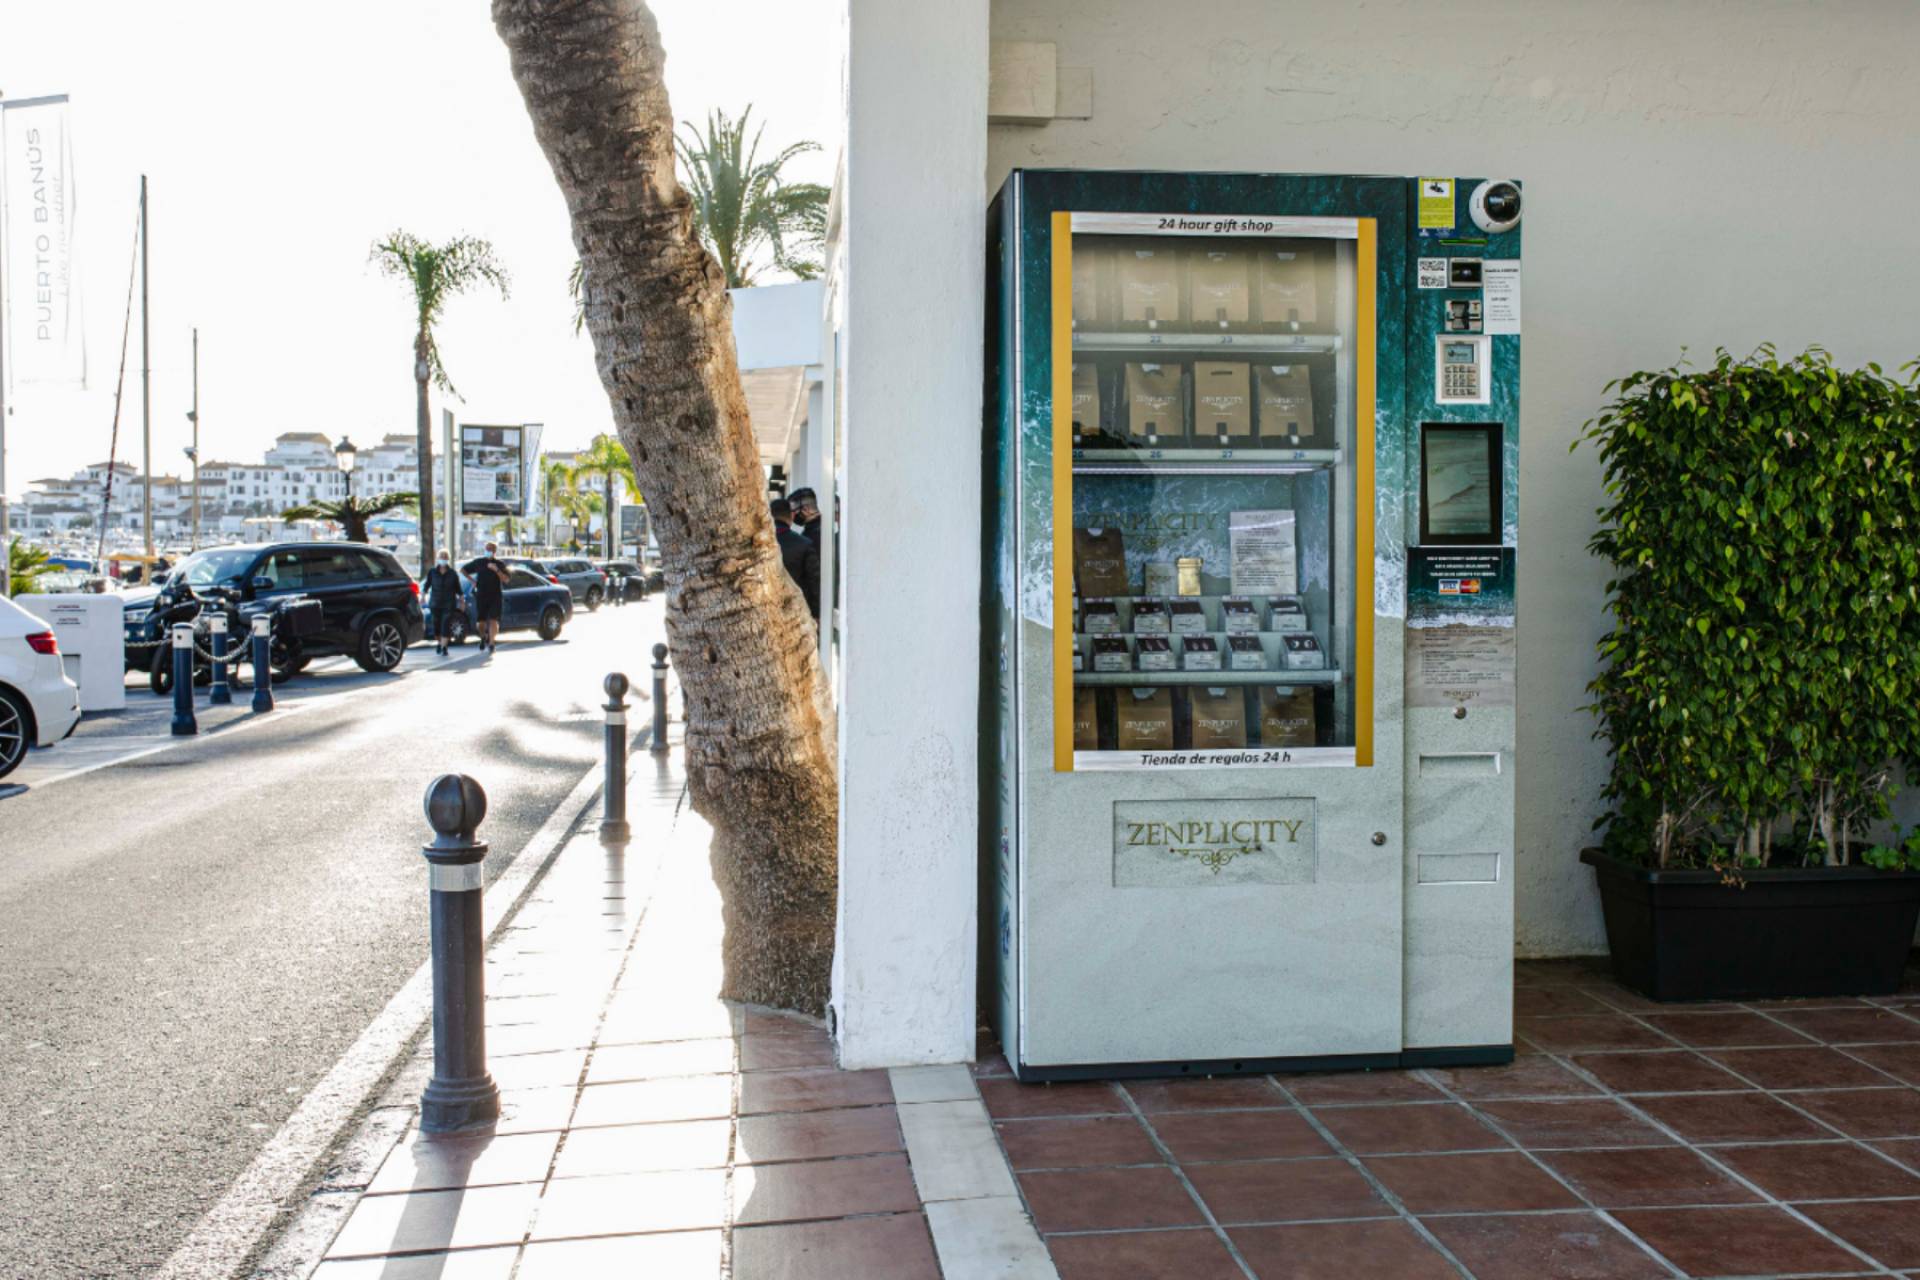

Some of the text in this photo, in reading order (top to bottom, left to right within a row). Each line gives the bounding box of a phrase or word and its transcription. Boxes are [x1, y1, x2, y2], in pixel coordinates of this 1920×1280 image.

[26, 127, 52, 341] PUERTO BANÚS
[1158, 218, 1273, 233] 24 hour gift shop
[1141, 751, 1291, 766] Tienda de regalos 24 h
[1126, 818, 1304, 846] ZENPLICITY
